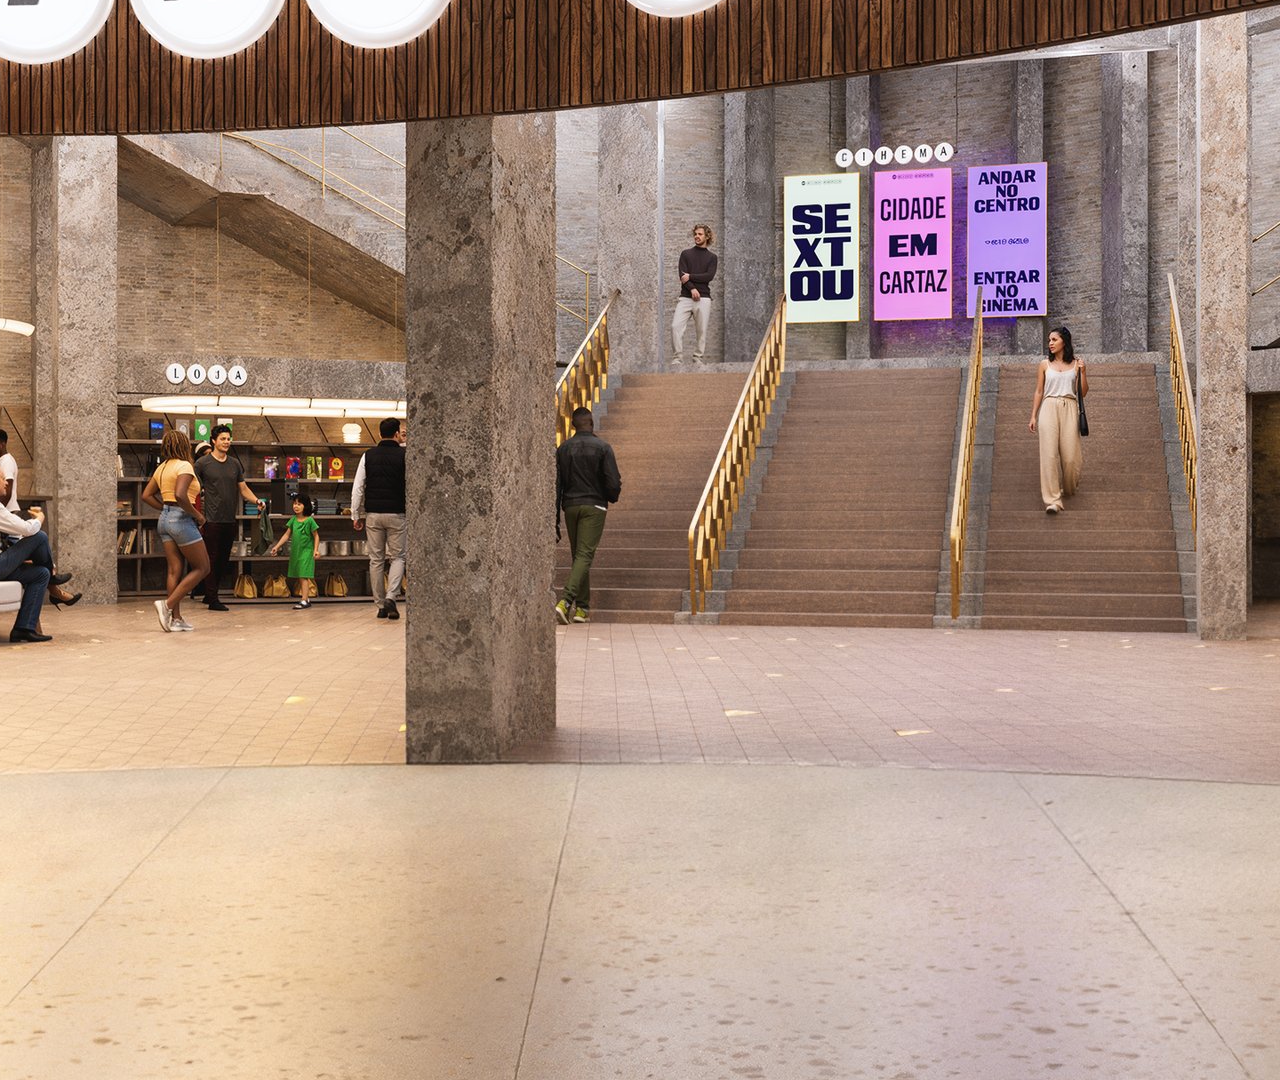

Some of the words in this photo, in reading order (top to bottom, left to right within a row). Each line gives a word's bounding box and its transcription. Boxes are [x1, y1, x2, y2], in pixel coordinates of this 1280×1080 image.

[978, 169, 1036, 185] ANDAR
[996, 184, 1018, 198] NO
[880, 196, 946, 221] CIDADE
[974, 197, 1040, 213] CENTRO
[792, 203, 852, 235] SE
[793, 236, 852, 268] XT
[889, 233, 938, 258] EM
[790, 269, 854, 302] OU
[879, 269, 947, 295] CARTAZ
[973, 270, 1040, 285] ENTRAR
[996, 285, 1019, 298] NO
[174, 368, 242, 380] LOJA
